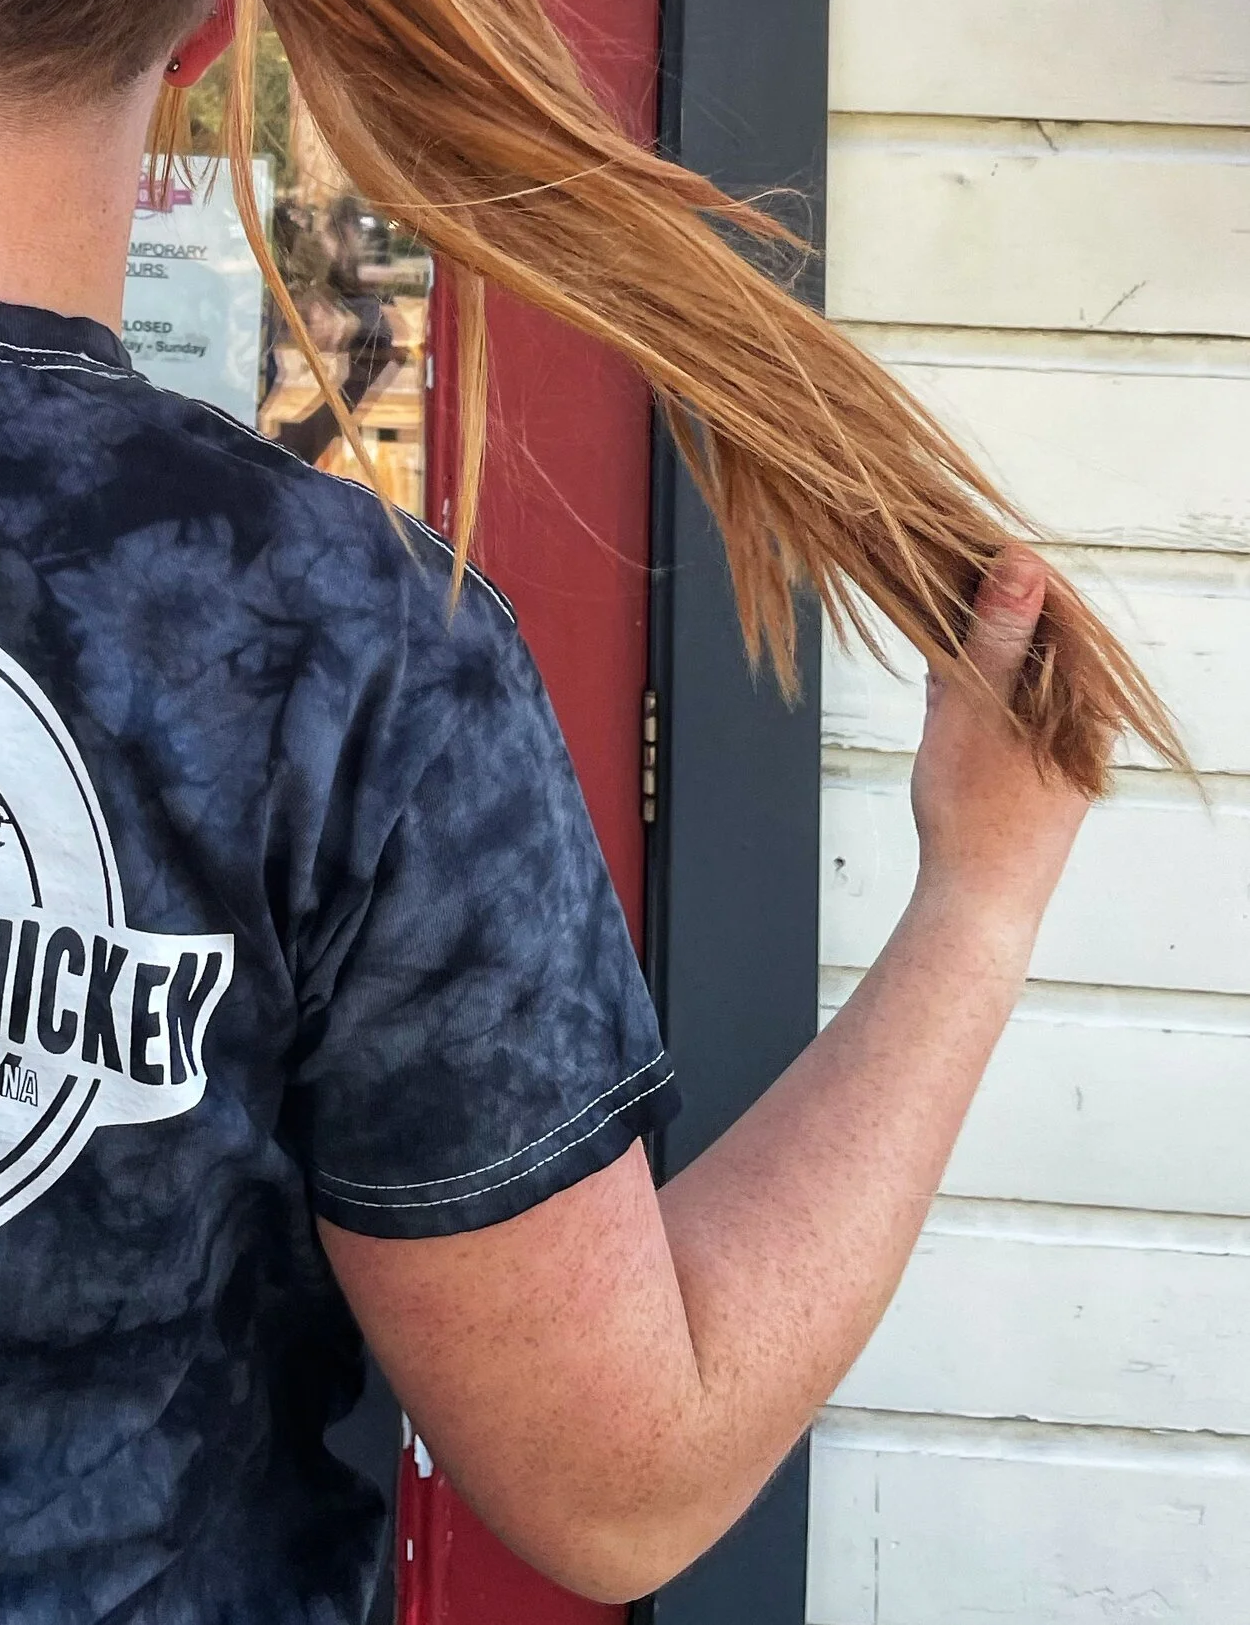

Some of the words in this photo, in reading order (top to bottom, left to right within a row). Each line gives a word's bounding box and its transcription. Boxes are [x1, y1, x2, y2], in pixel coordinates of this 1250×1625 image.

[129, 242, 208, 260] MPORARY
[122, 320, 173, 334] LOSED
[155, 340, 207, 358] Sunday
